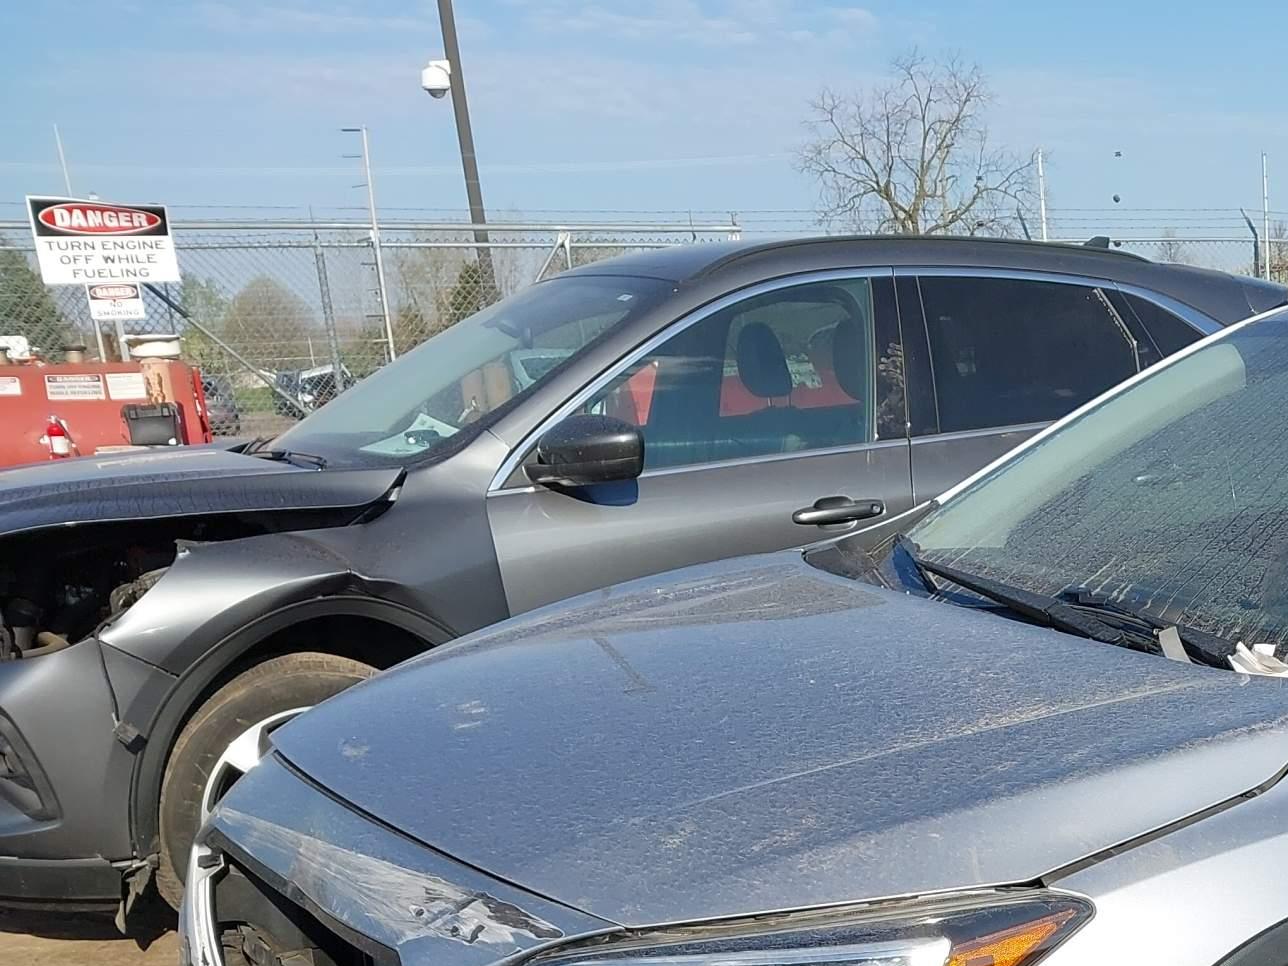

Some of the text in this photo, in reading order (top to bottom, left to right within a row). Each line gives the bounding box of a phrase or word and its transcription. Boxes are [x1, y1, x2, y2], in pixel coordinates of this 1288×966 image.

[53, 208, 149, 228] DANGER
[44, 240, 166, 251] TURN ENGINE
[59, 253, 158, 265] OFF WHILE
[72, 268, 150, 279] FUELING
[94, 287, 133, 297] DANGER
[97, 309, 140, 317] SMOKING
